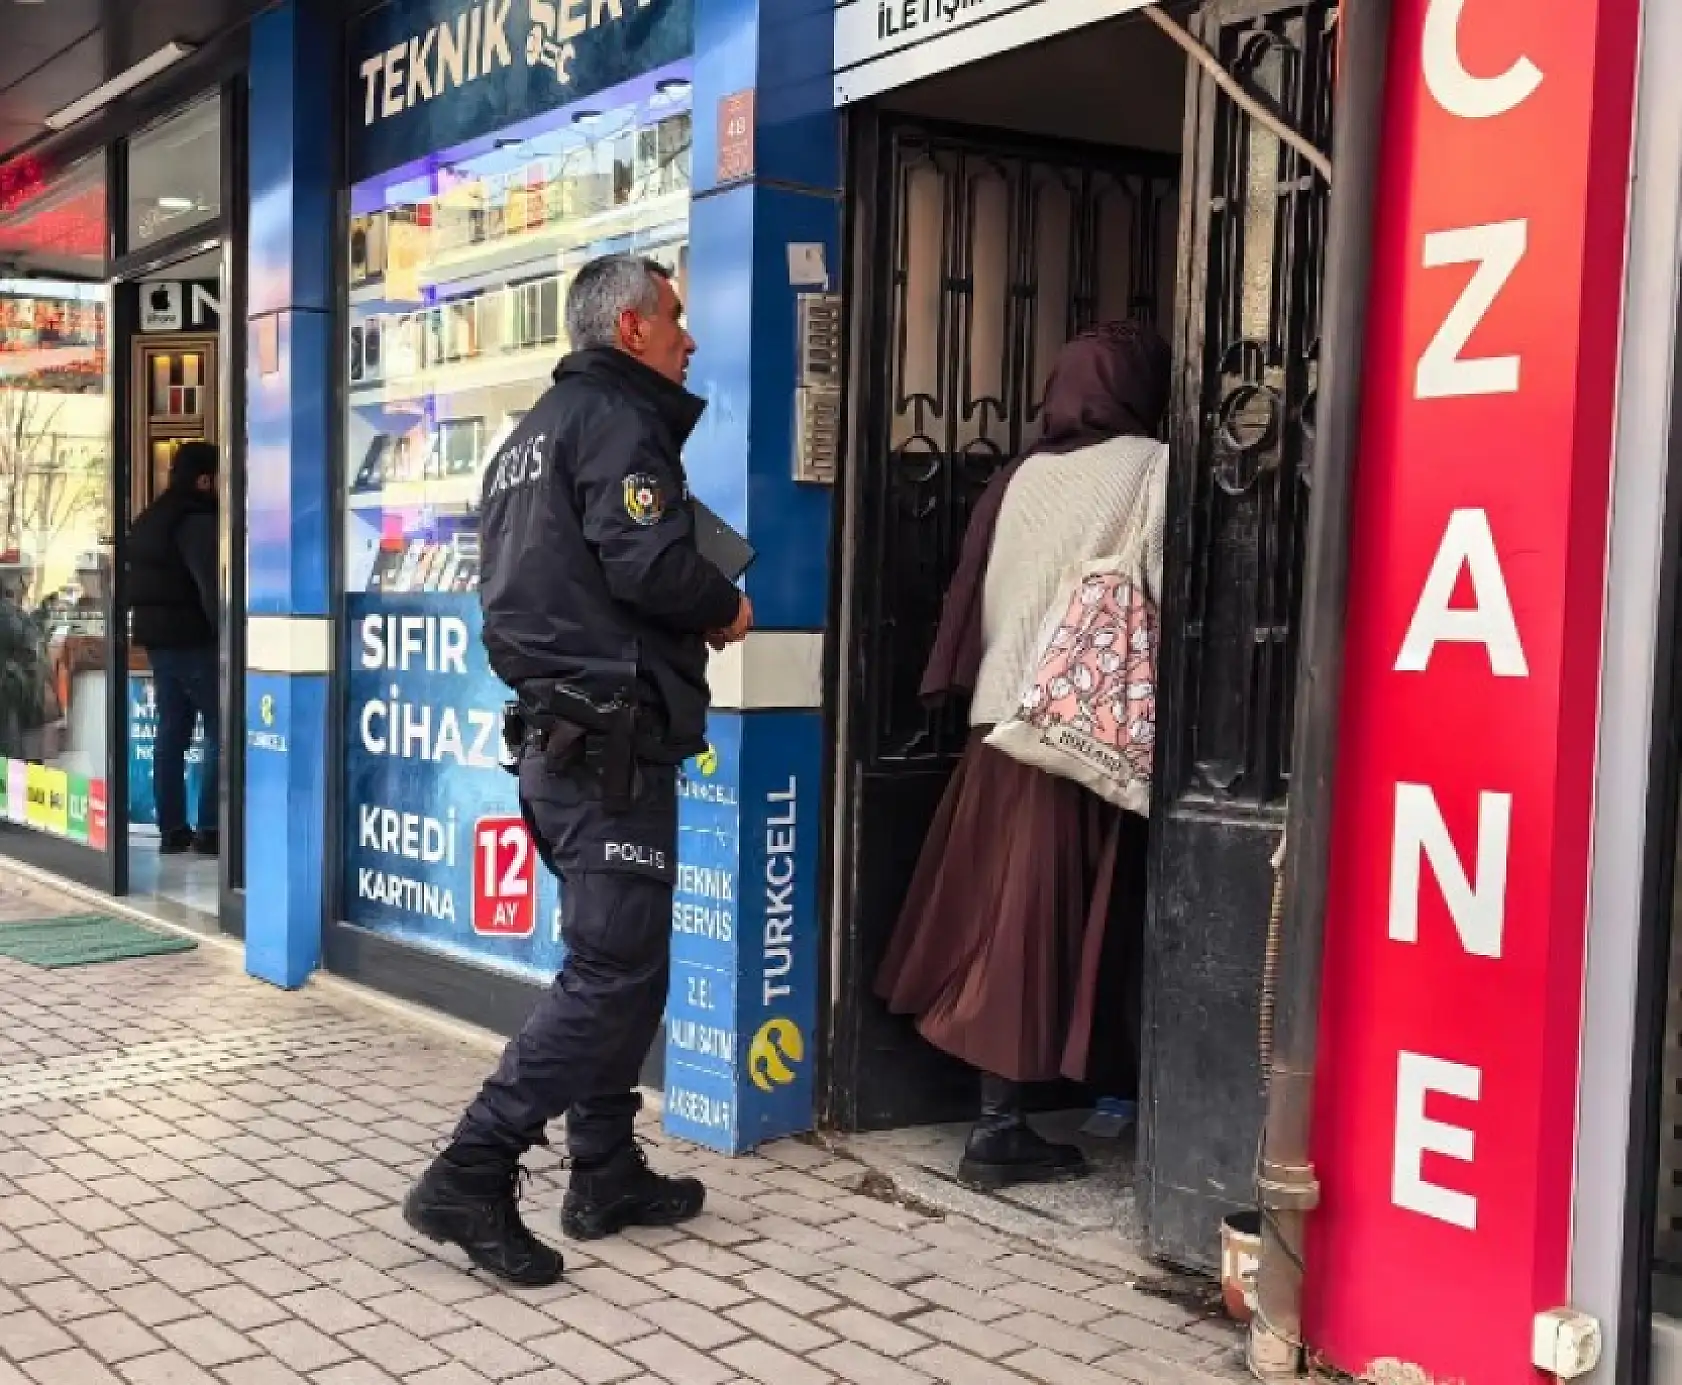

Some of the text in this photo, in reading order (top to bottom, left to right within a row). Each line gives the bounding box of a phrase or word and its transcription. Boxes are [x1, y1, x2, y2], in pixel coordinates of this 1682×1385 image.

[361, 614, 469, 673] SIFIR
[359, 803, 455, 866] KREDİ
[478, 825, 528, 898] 12
[358, 867, 455, 922] KARTINA
[492, 901, 520, 926] AY
[763, 775, 797, 1006] TURKCELL
